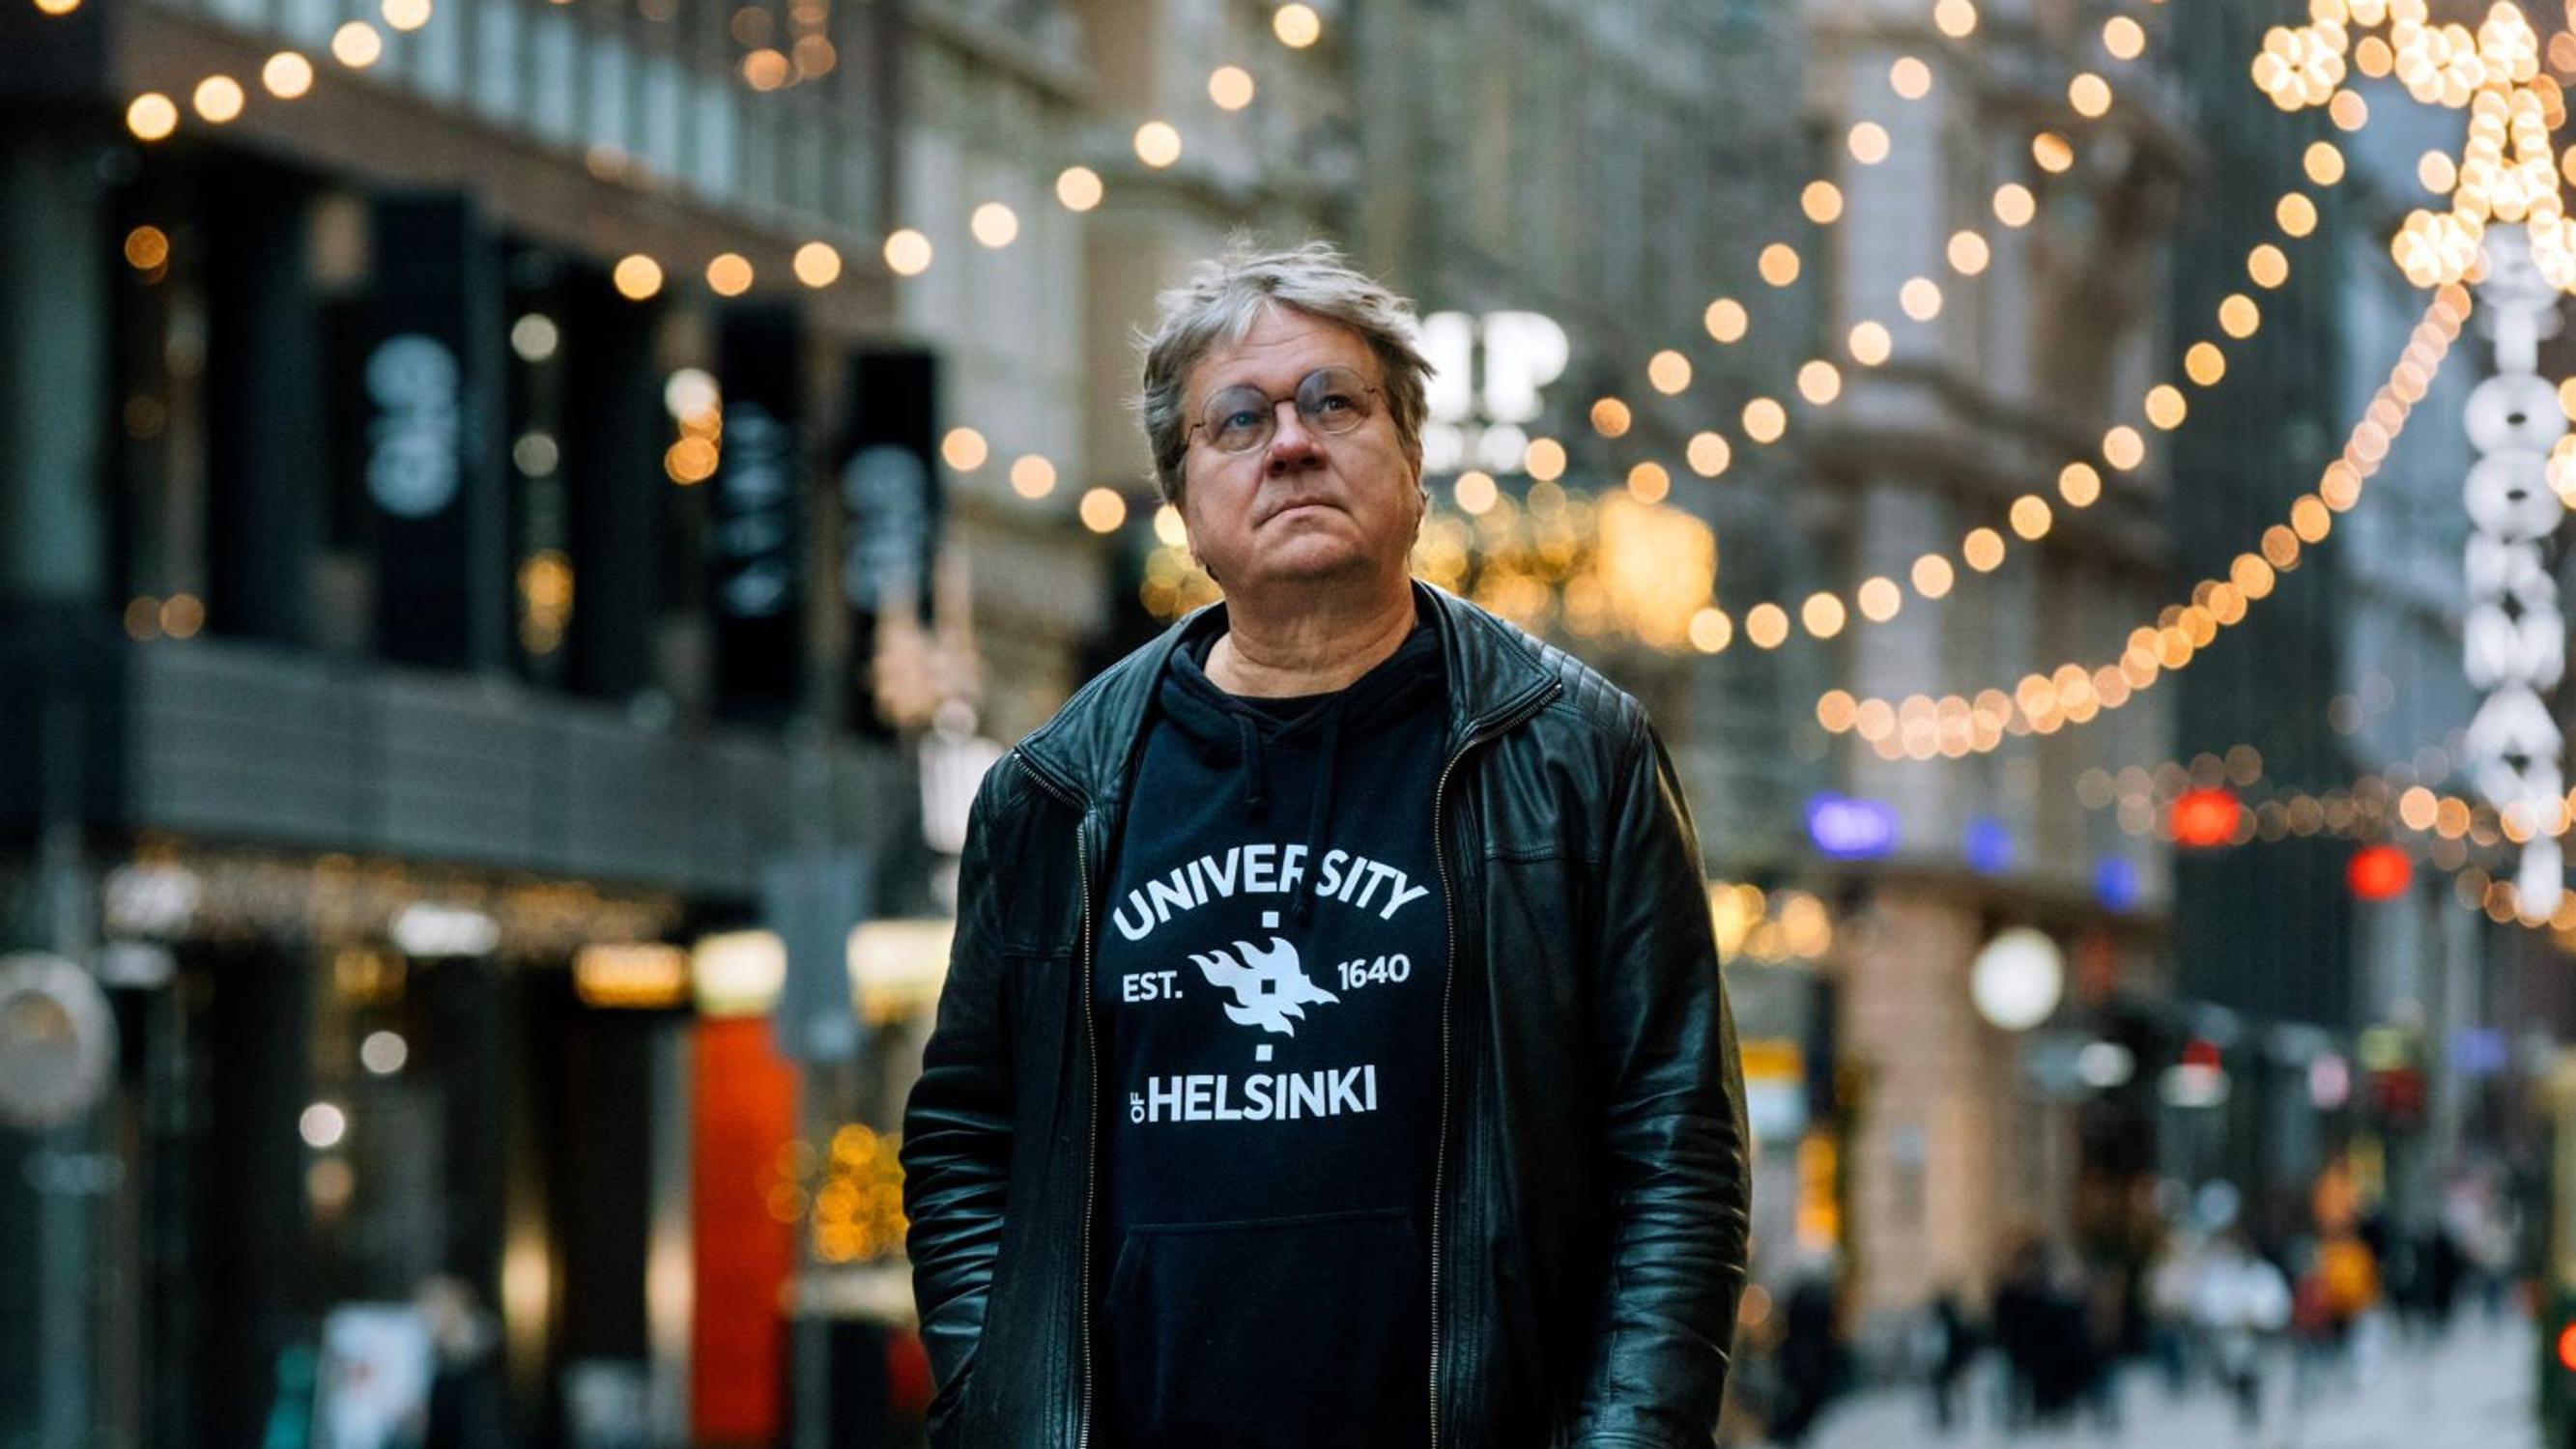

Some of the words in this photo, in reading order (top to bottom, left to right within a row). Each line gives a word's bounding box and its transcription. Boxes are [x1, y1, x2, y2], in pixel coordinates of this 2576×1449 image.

[1113, 844, 1429, 941] UNIVERSITY
[1123, 971, 1183, 1002] EST.
[1337, 953, 1411, 991] 1640
[1130, 1092, 1145, 1123] OF
[1149, 1065, 1377, 1122] HELSINKI
